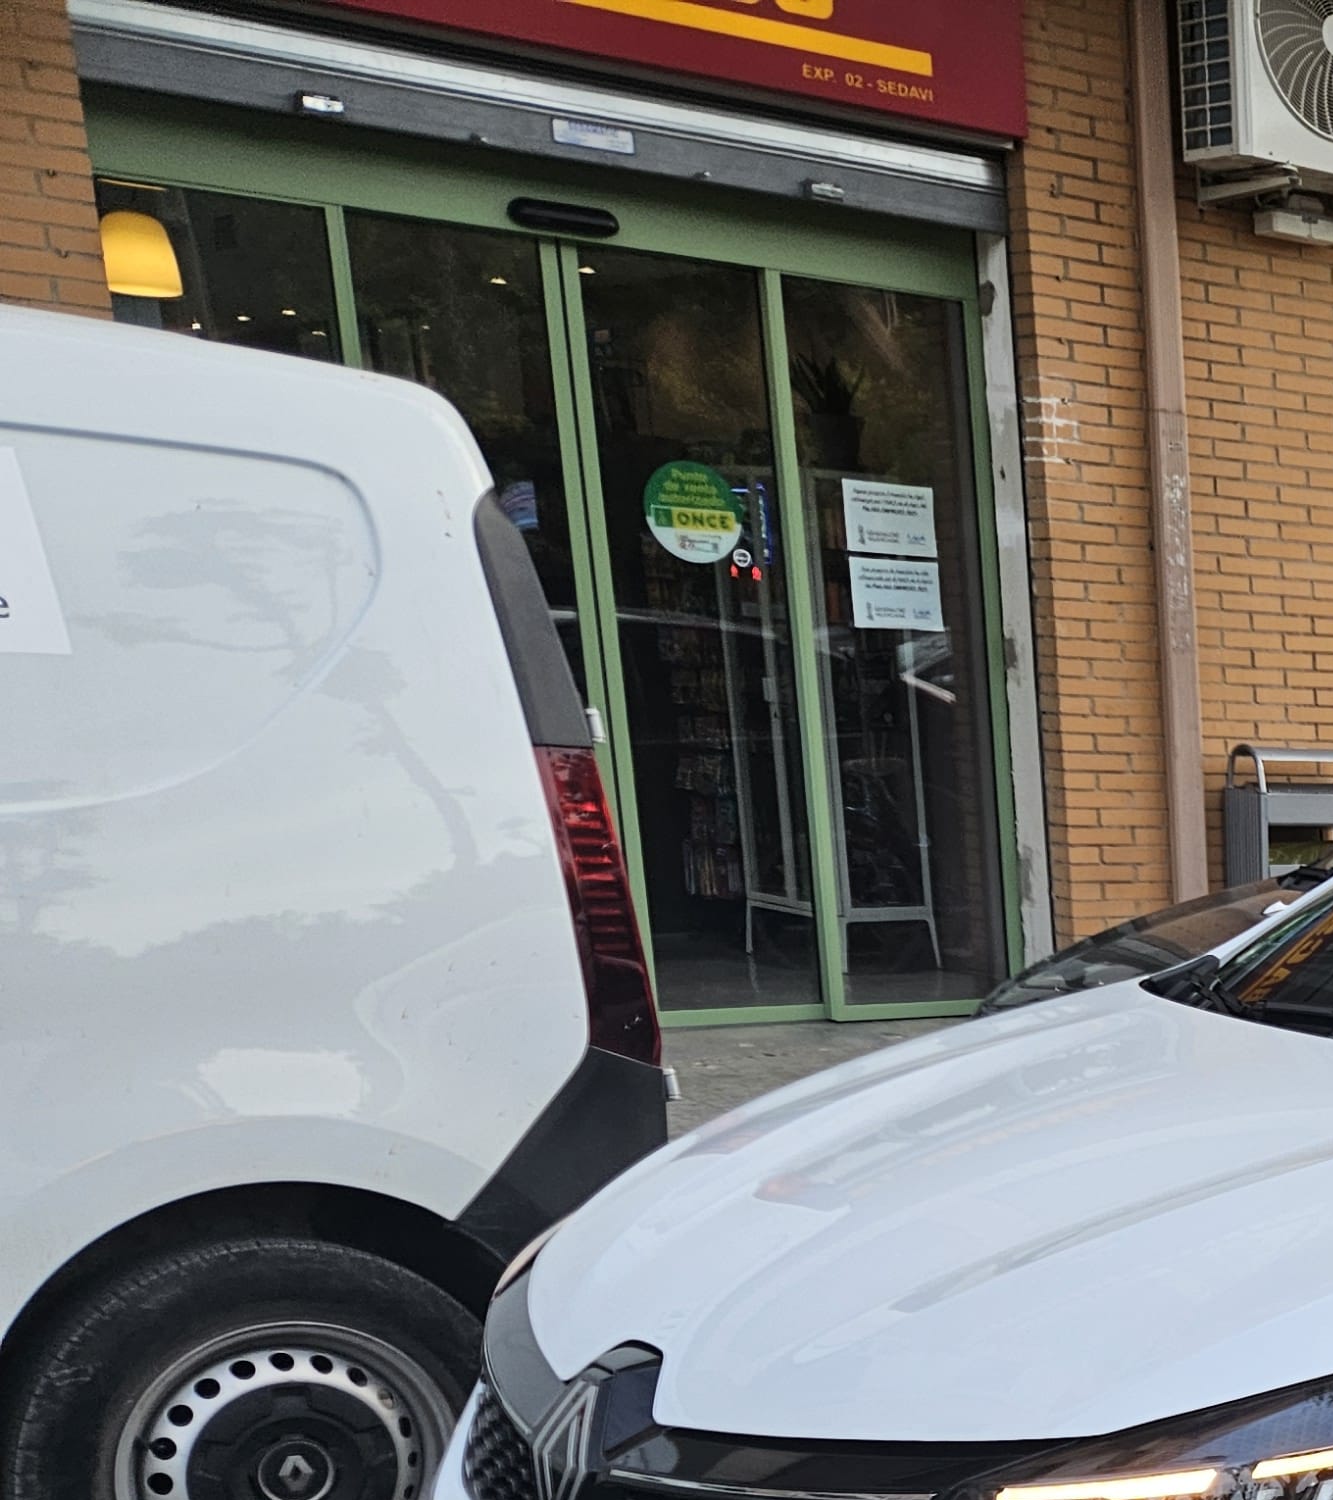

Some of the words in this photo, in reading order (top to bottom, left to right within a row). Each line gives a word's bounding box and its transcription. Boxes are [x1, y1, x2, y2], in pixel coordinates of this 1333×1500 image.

[802, 63, 837, 83] EXP.
[845, 72, 864, 88] 02
[676, 511, 731, 530] ONCE
